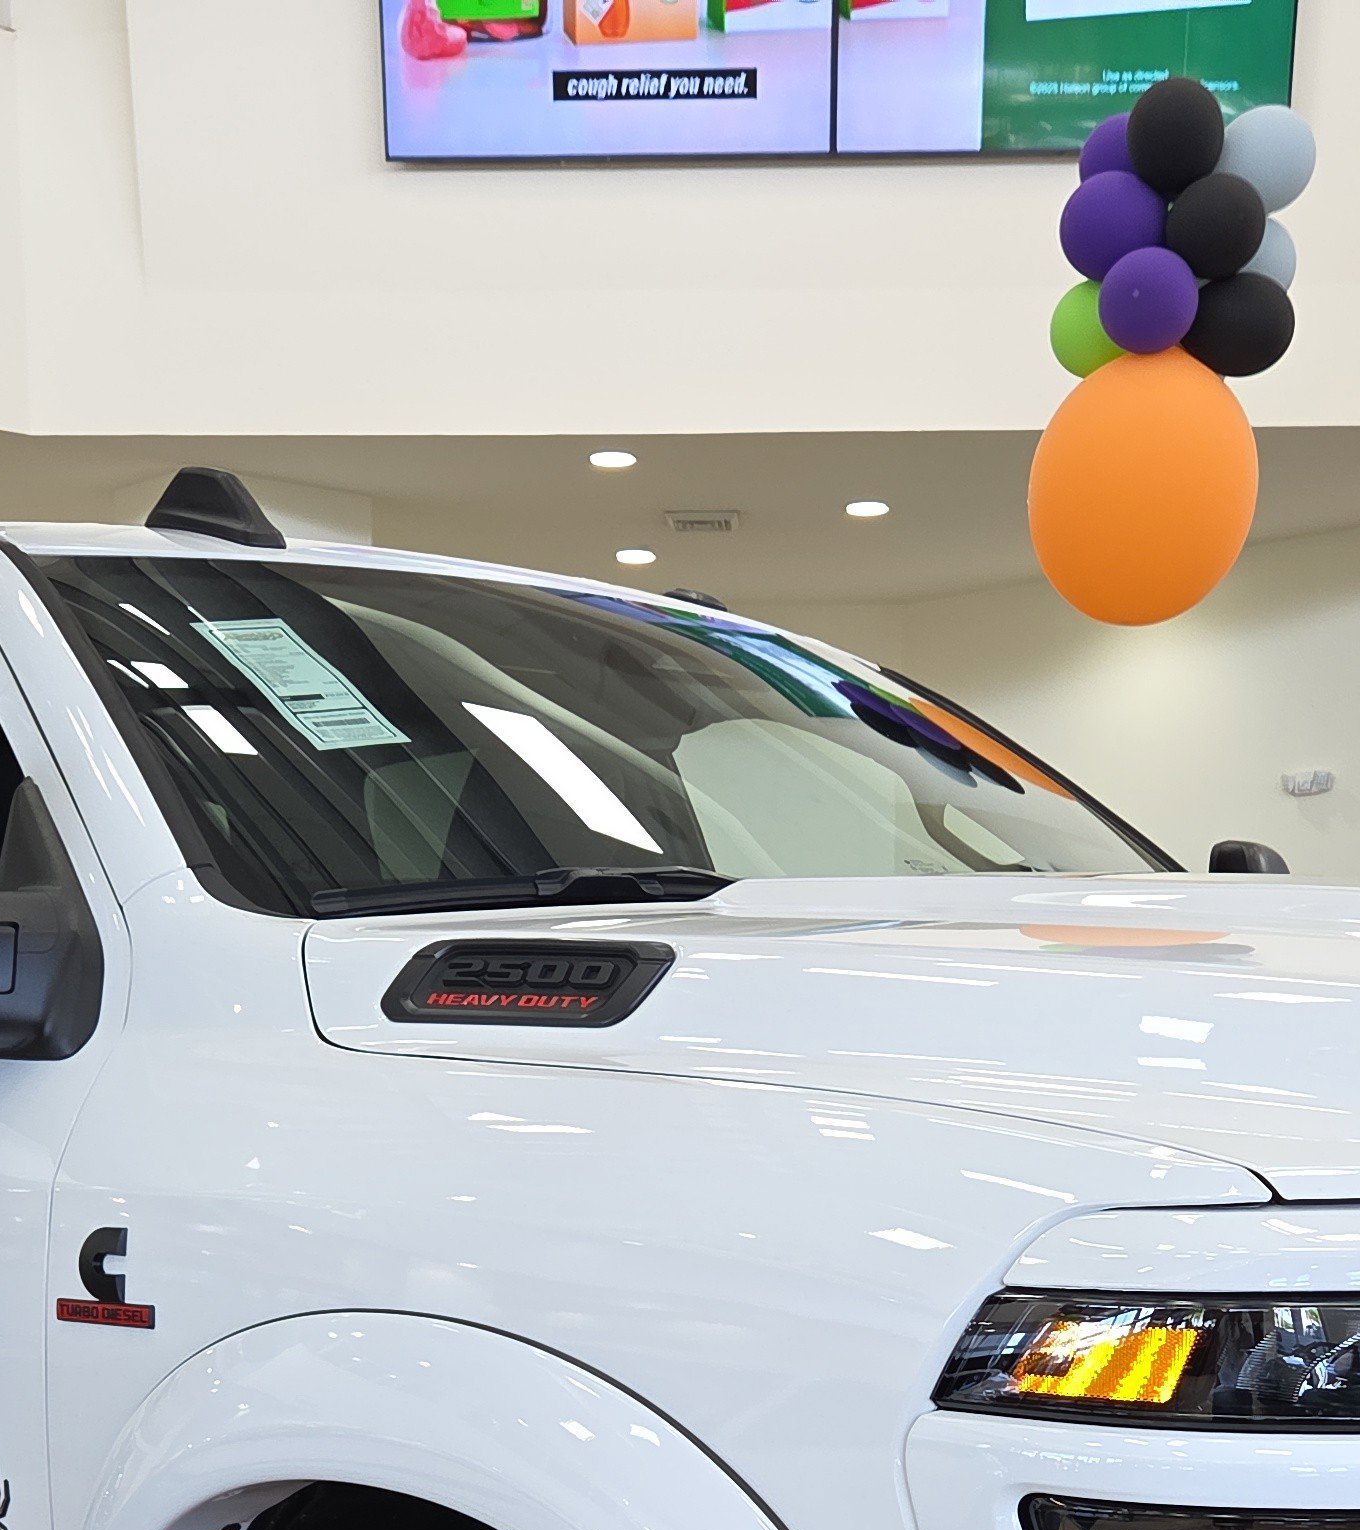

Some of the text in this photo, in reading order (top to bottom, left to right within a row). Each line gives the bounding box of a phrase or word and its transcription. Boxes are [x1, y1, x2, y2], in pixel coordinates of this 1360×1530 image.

[567, 72, 749, 100] cough relief you need.
[443, 957, 616, 988] 2500
[427, 993, 598, 1009] HEAVY DUTY
[60, 1304, 149, 1323] TURBO DIESEL
